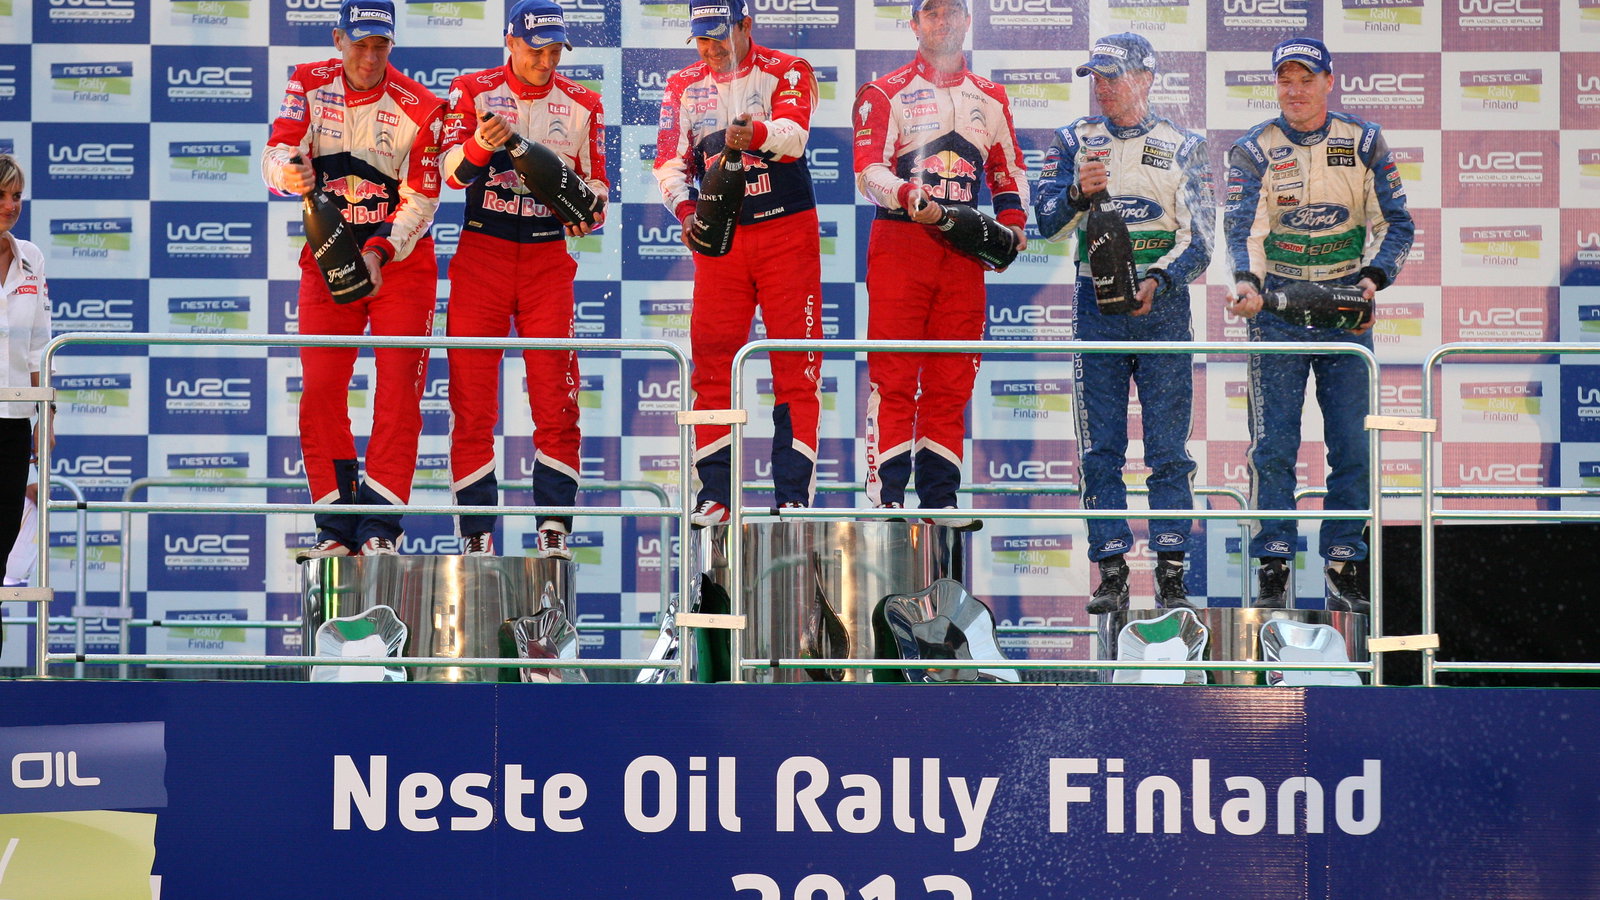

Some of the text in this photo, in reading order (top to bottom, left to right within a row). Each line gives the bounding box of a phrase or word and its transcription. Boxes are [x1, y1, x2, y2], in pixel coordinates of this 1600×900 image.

[198, 2, 225, 14] Rally
[433, 3, 460, 16] Rally
[693, 7, 728, 16] MICHELIN
[1370, 8, 1397, 20] Rally
[192, 15, 228, 25] Finland
[427, 16, 463, 27] Finland
[662, 18, 690, 28] Finlan
[1365, 22, 1400, 32] Finland
[104, 66, 121, 74] OIL
[168, 66, 252, 85] WRC
[1341, 74, 1424, 91] WRC
[1514, 73, 1531, 81] OIL
[79, 78, 107, 92] Rally
[1019, 85, 1046, 96] Rally
[73, 91, 109, 102] Finland
[1488, 86, 1516, 98] Rally
[1013, 97, 1048, 108] Finland
[1483, 100, 1518, 110] Finland
[1085, 137, 1105, 145] Ford
[49, 143, 134, 162] WRC
[222, 145, 239, 153] OIL
[197, 157, 224, 171] Rally
[1153, 159, 1169, 168] IWS
[1340, 157, 1353, 166] IWS
[1459, 152, 1543, 169] WRC
[191, 170, 227, 181] Finland
[949, 181, 974, 202] Bull
[482, 191, 519, 216] Red
[354, 202, 389, 225] Bull
[764, 206, 785, 217] ELENA
[1291, 206, 1338, 227] Ford
[103, 222, 121, 230] OIL
[167, 222, 252, 241] WRC
[78, 234, 106, 248] Rally
[314, 221, 346, 260] FREIXENET
[1131, 238, 1173, 251] DGE
[72, 247, 108, 258] Finland
[1027, 241, 1046, 253] ally
[1309, 238, 1352, 256] EDGE
[1488, 242, 1515, 254] Rally
[1483, 256, 1518, 266] Finland
[51, 300, 133, 318] WRC
[221, 300, 239, 308] OIL
[990, 305, 1073, 323] WRC
[1396, 307, 1412, 315] OIL
[1459, 307, 1543, 326] WRC
[195, 313, 224, 327] Rally
[102, 377, 120, 385] OIL
[166, 378, 251, 397] WRC
[77, 390, 104, 404] Rally
[1019, 395, 1046, 409] Rally
[71, 403, 107, 414] Finland
[1489, 398, 1516, 410] Rally
[1013, 408, 1049, 419] Finland
[1483, 412, 1519, 421] Finland
[50, 456, 132, 474] WRC
[220, 456, 238, 464] OIL
[866, 446, 877, 484] LOEB
[990, 461, 1073, 479] WRC
[1460, 464, 1543, 481] WRC
[165, 534, 250, 553] WRC
[1044, 539, 1061, 547] OIL
[1159, 533, 1179, 544] Ford
[1105, 540, 1124, 550] Ford
[1270, 542, 1289, 552] Ford
[1019, 551, 1046, 564] Rally
[1332, 547, 1351, 557] Ford
[1014, 564, 1049, 575] Finland
[188, 639, 224, 650] Finland
[11, 750, 101, 788] OIL
[333, 754, 1382, 852] Neste Oil Rally Finland
